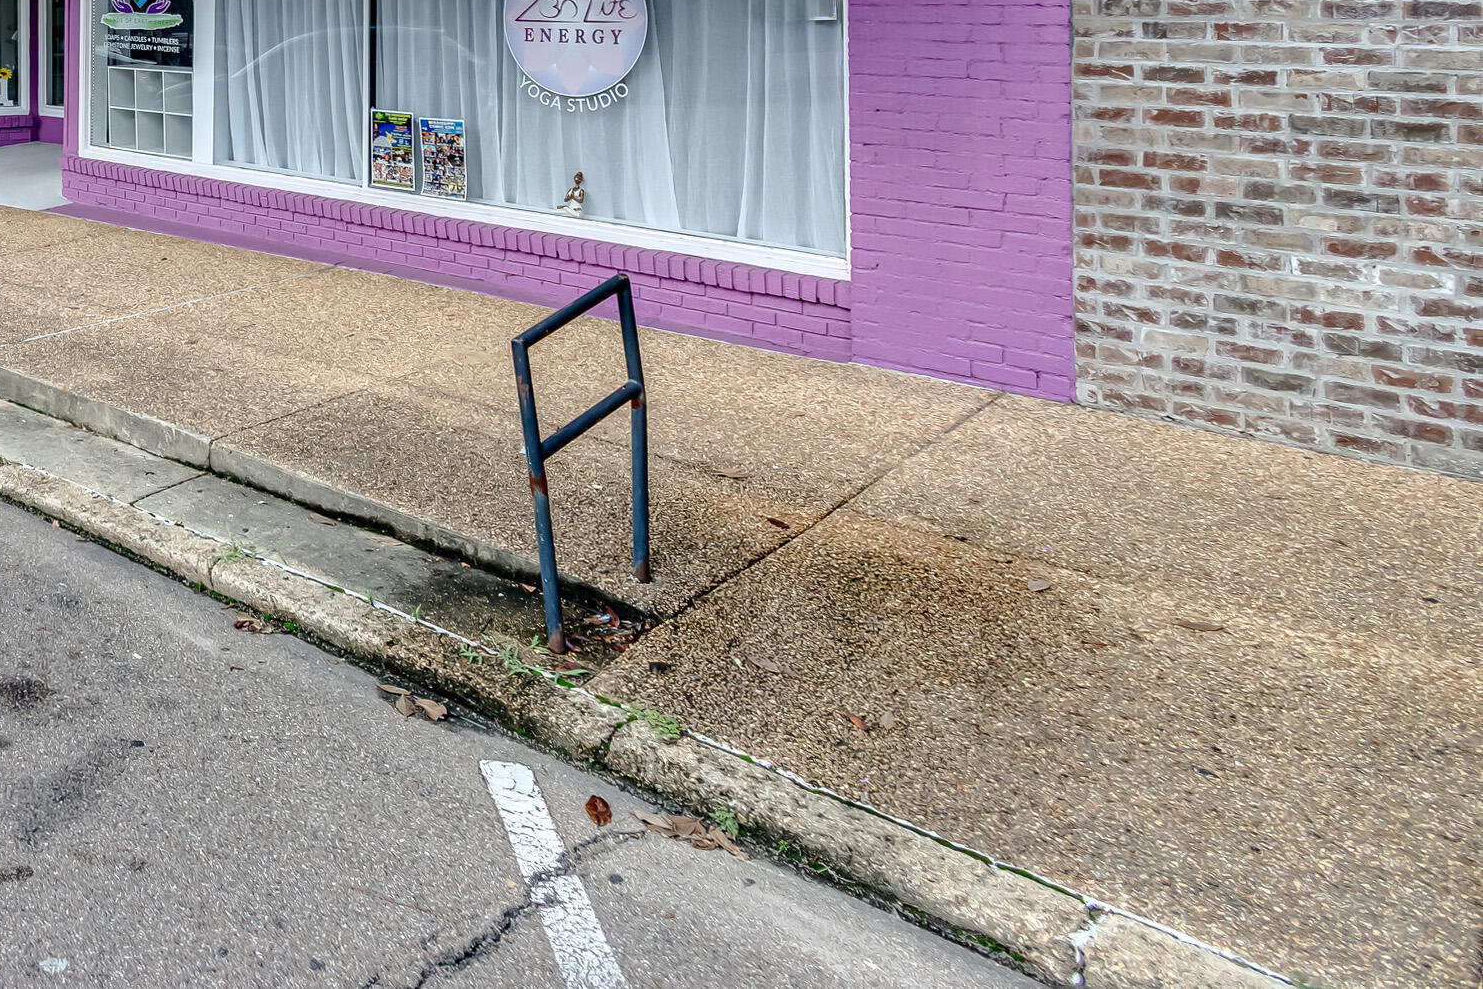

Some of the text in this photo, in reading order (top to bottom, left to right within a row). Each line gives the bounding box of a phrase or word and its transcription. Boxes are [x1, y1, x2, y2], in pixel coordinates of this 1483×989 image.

[124, 35, 147, 43] CANDLES
[151, 37, 179, 45] TUMBLERS
[524, 27, 623, 45] ENERGY
[519, 74, 629, 113] YOGA STUDIO
